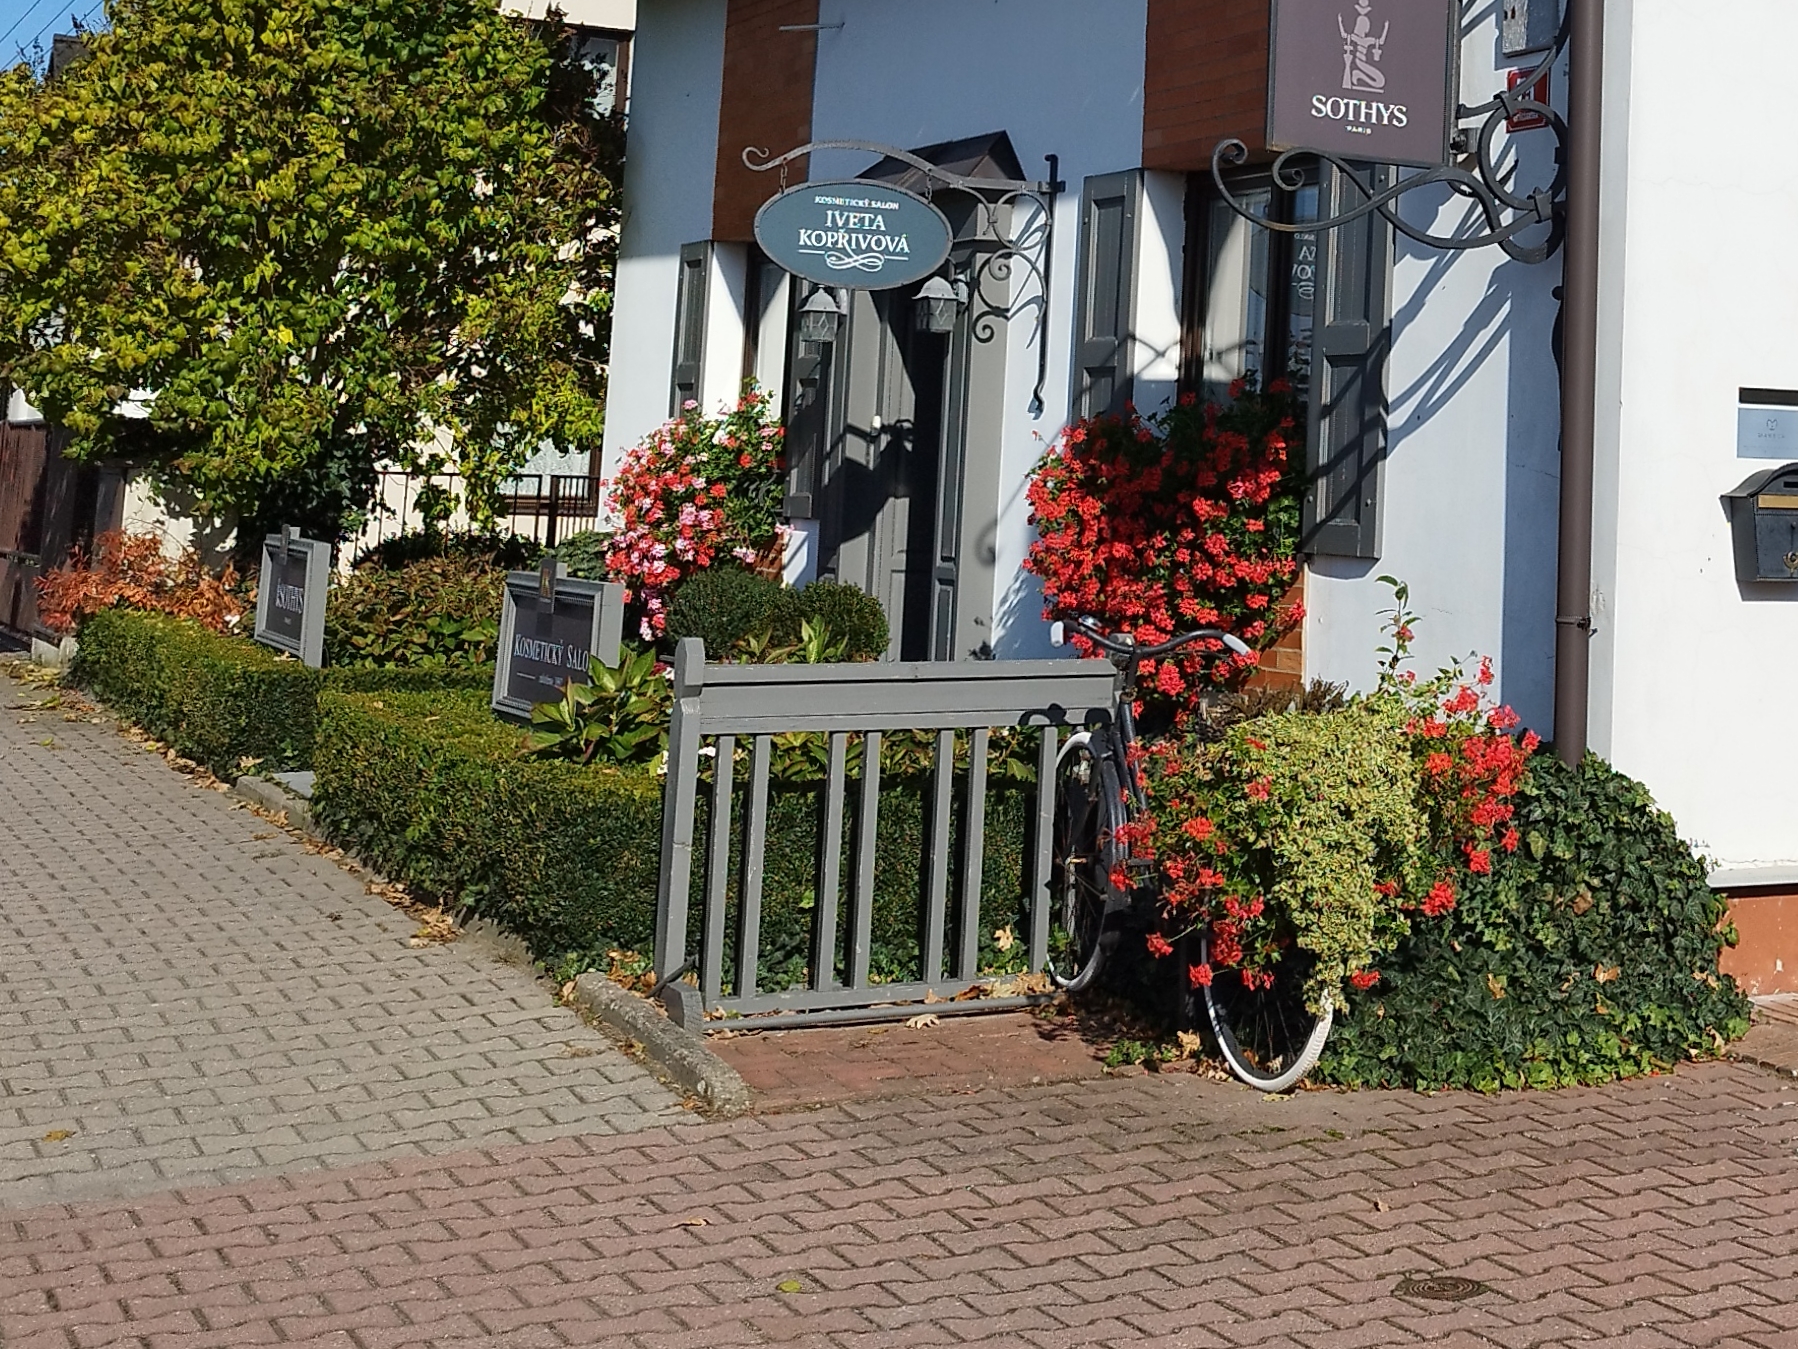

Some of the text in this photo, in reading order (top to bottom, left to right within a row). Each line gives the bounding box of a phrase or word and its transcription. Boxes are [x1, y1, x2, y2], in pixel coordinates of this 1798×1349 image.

[1311, 94, 1408, 128] SOTHYS
[871, 200, 899, 210] SALON
[825, 209, 886, 230] IVETA
[799, 228, 910, 253] KOPŘIVOVÁ
[567, 645, 589, 671] SALO
